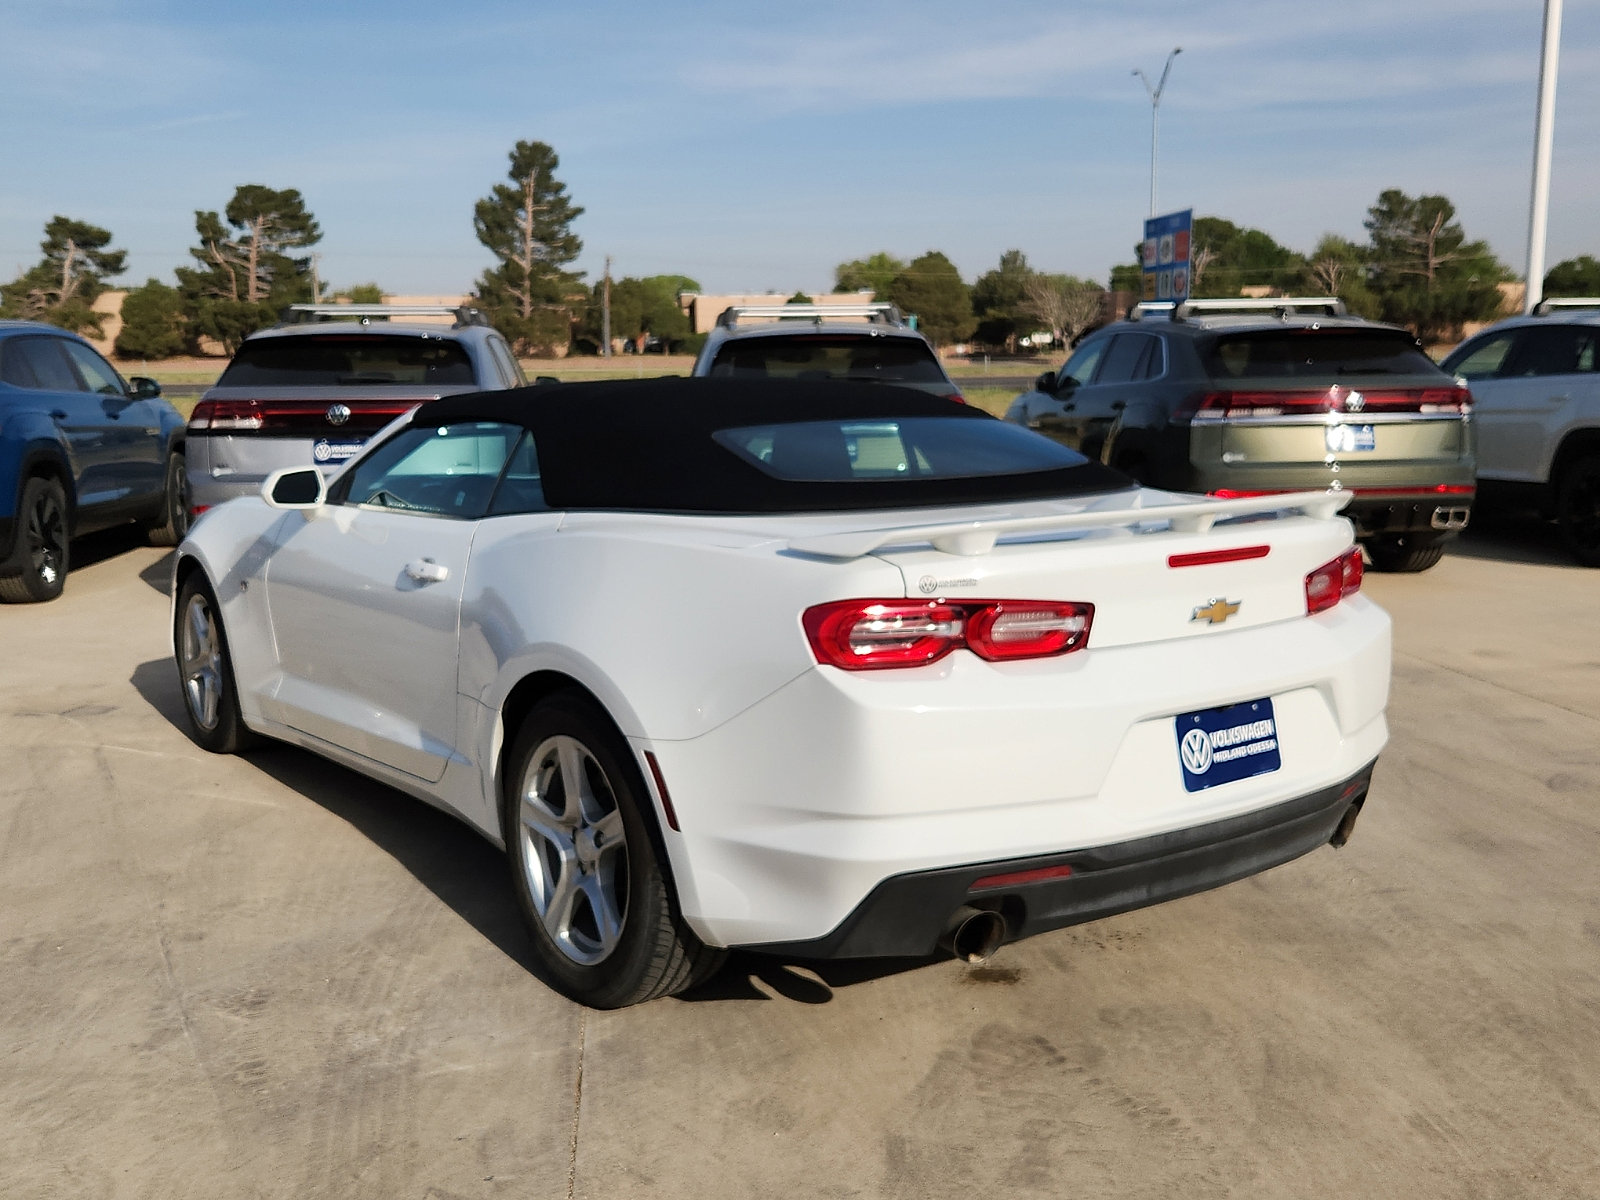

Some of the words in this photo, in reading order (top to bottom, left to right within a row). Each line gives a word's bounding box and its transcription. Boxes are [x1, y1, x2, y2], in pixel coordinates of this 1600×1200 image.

[919, 575, 938, 594] VW
[1209, 719, 1274, 748] VOLKSWAGEN
[1181, 728, 1212, 775] VW
[1213, 745, 1248, 763] MIDLAND
[1247, 739, 1276, 755] ODESSA
